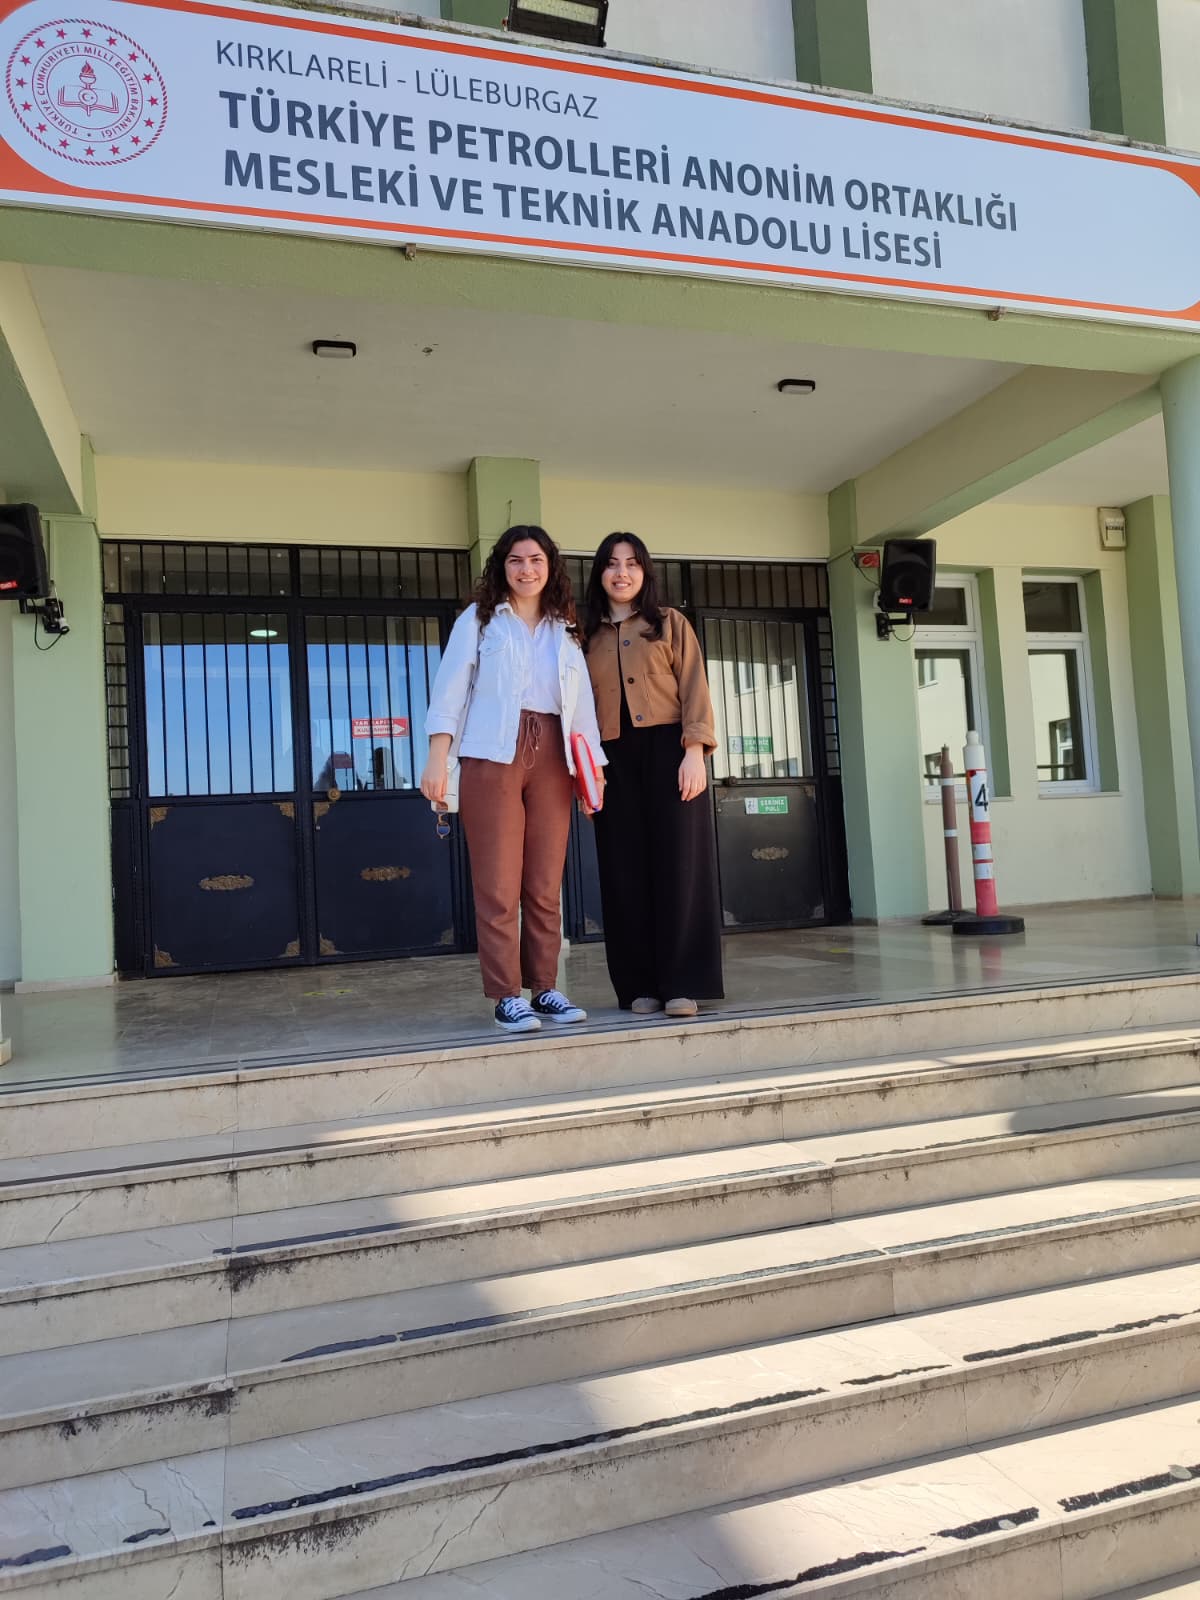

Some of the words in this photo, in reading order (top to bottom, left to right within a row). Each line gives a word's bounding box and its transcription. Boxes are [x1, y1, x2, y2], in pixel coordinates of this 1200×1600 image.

[36, 45, 80, 96] CUMHURİYETİ
[114, 61, 139, 96] EĞİTİM
[216, 39, 388, 89] KIRKLARELİ
[415, 68, 599, 120] LÜLEBURGAZ
[101, 98, 139, 138] BAKANLIĞI
[219, 86, 416, 152] TÜRKİYE
[428, 119, 670, 185] PETROLLERİ
[682, 155, 835, 207] ANONİM
[844, 178, 1017, 232] ORTAKLIĞI
[224, 149, 419, 208] MESLEKİ
[429, 174, 484, 215] VE
[492, 182, 642, 233] TEKNİK
[651, 202, 832, 255] ANADOLU
[842, 221, 942, 269] LİSESİ
[975, 783, 989, 812] 4
